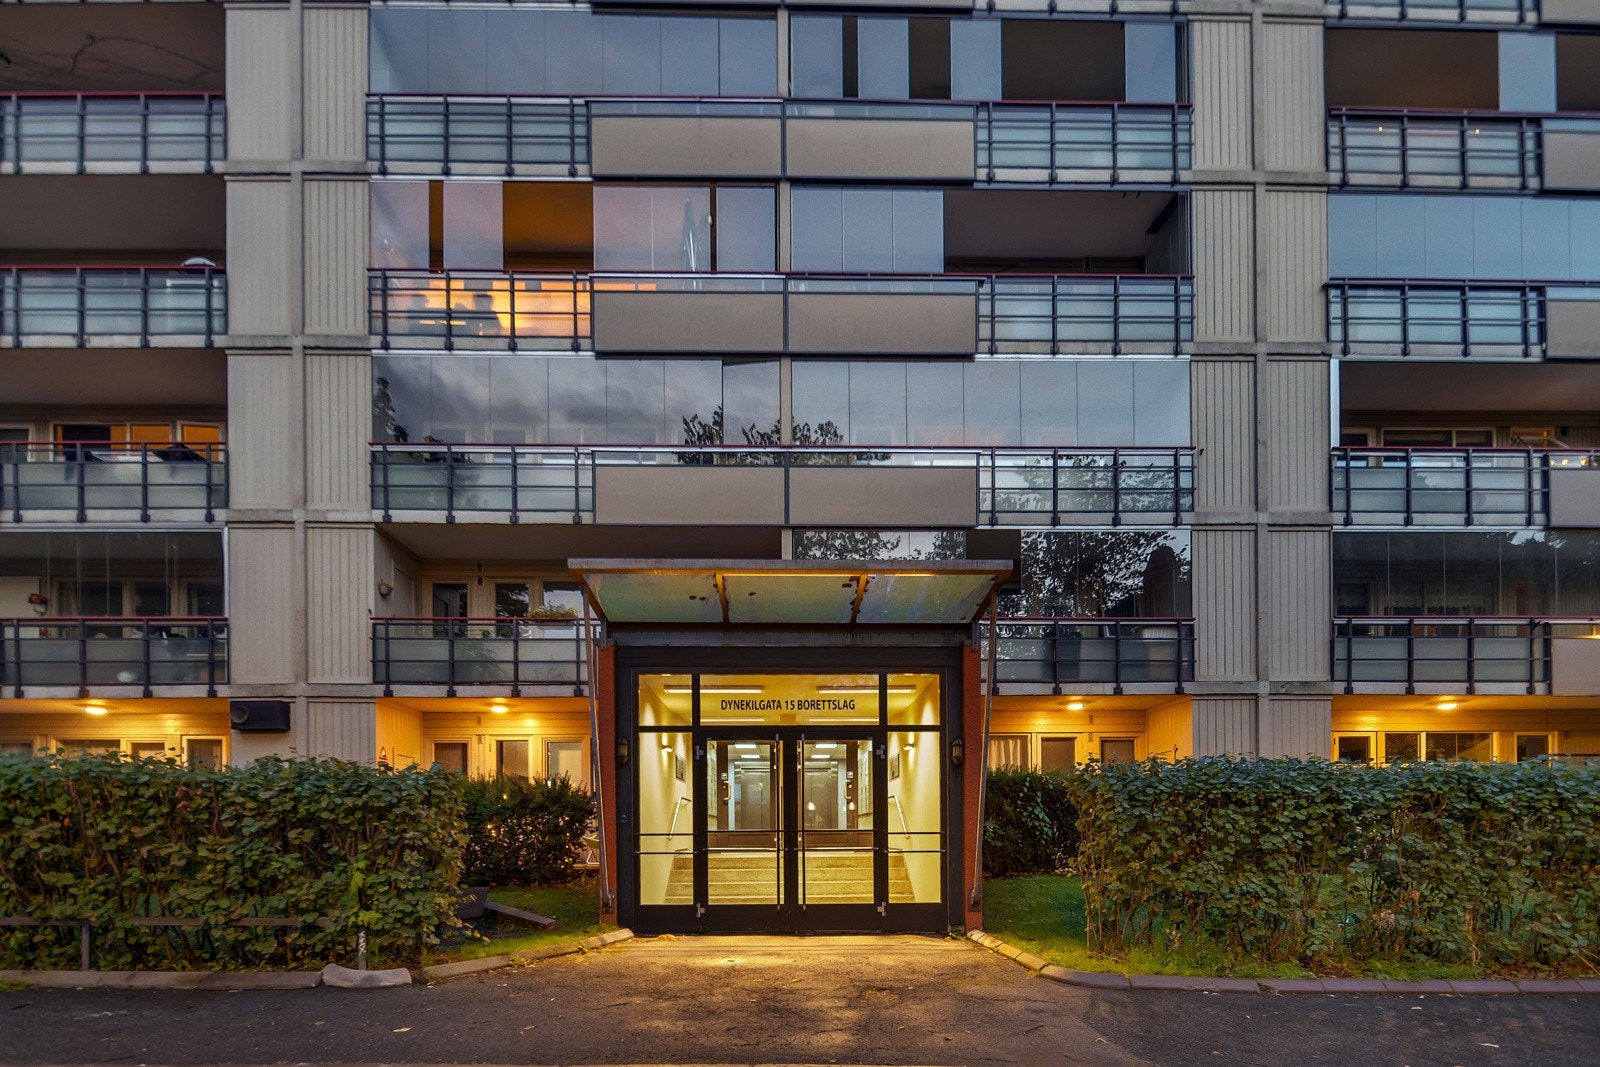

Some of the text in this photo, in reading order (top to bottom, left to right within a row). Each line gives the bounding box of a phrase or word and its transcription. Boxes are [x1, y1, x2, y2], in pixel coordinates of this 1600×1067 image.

[721, 700, 855, 710] DYNEKILGATA 15 BORETTSLAG
